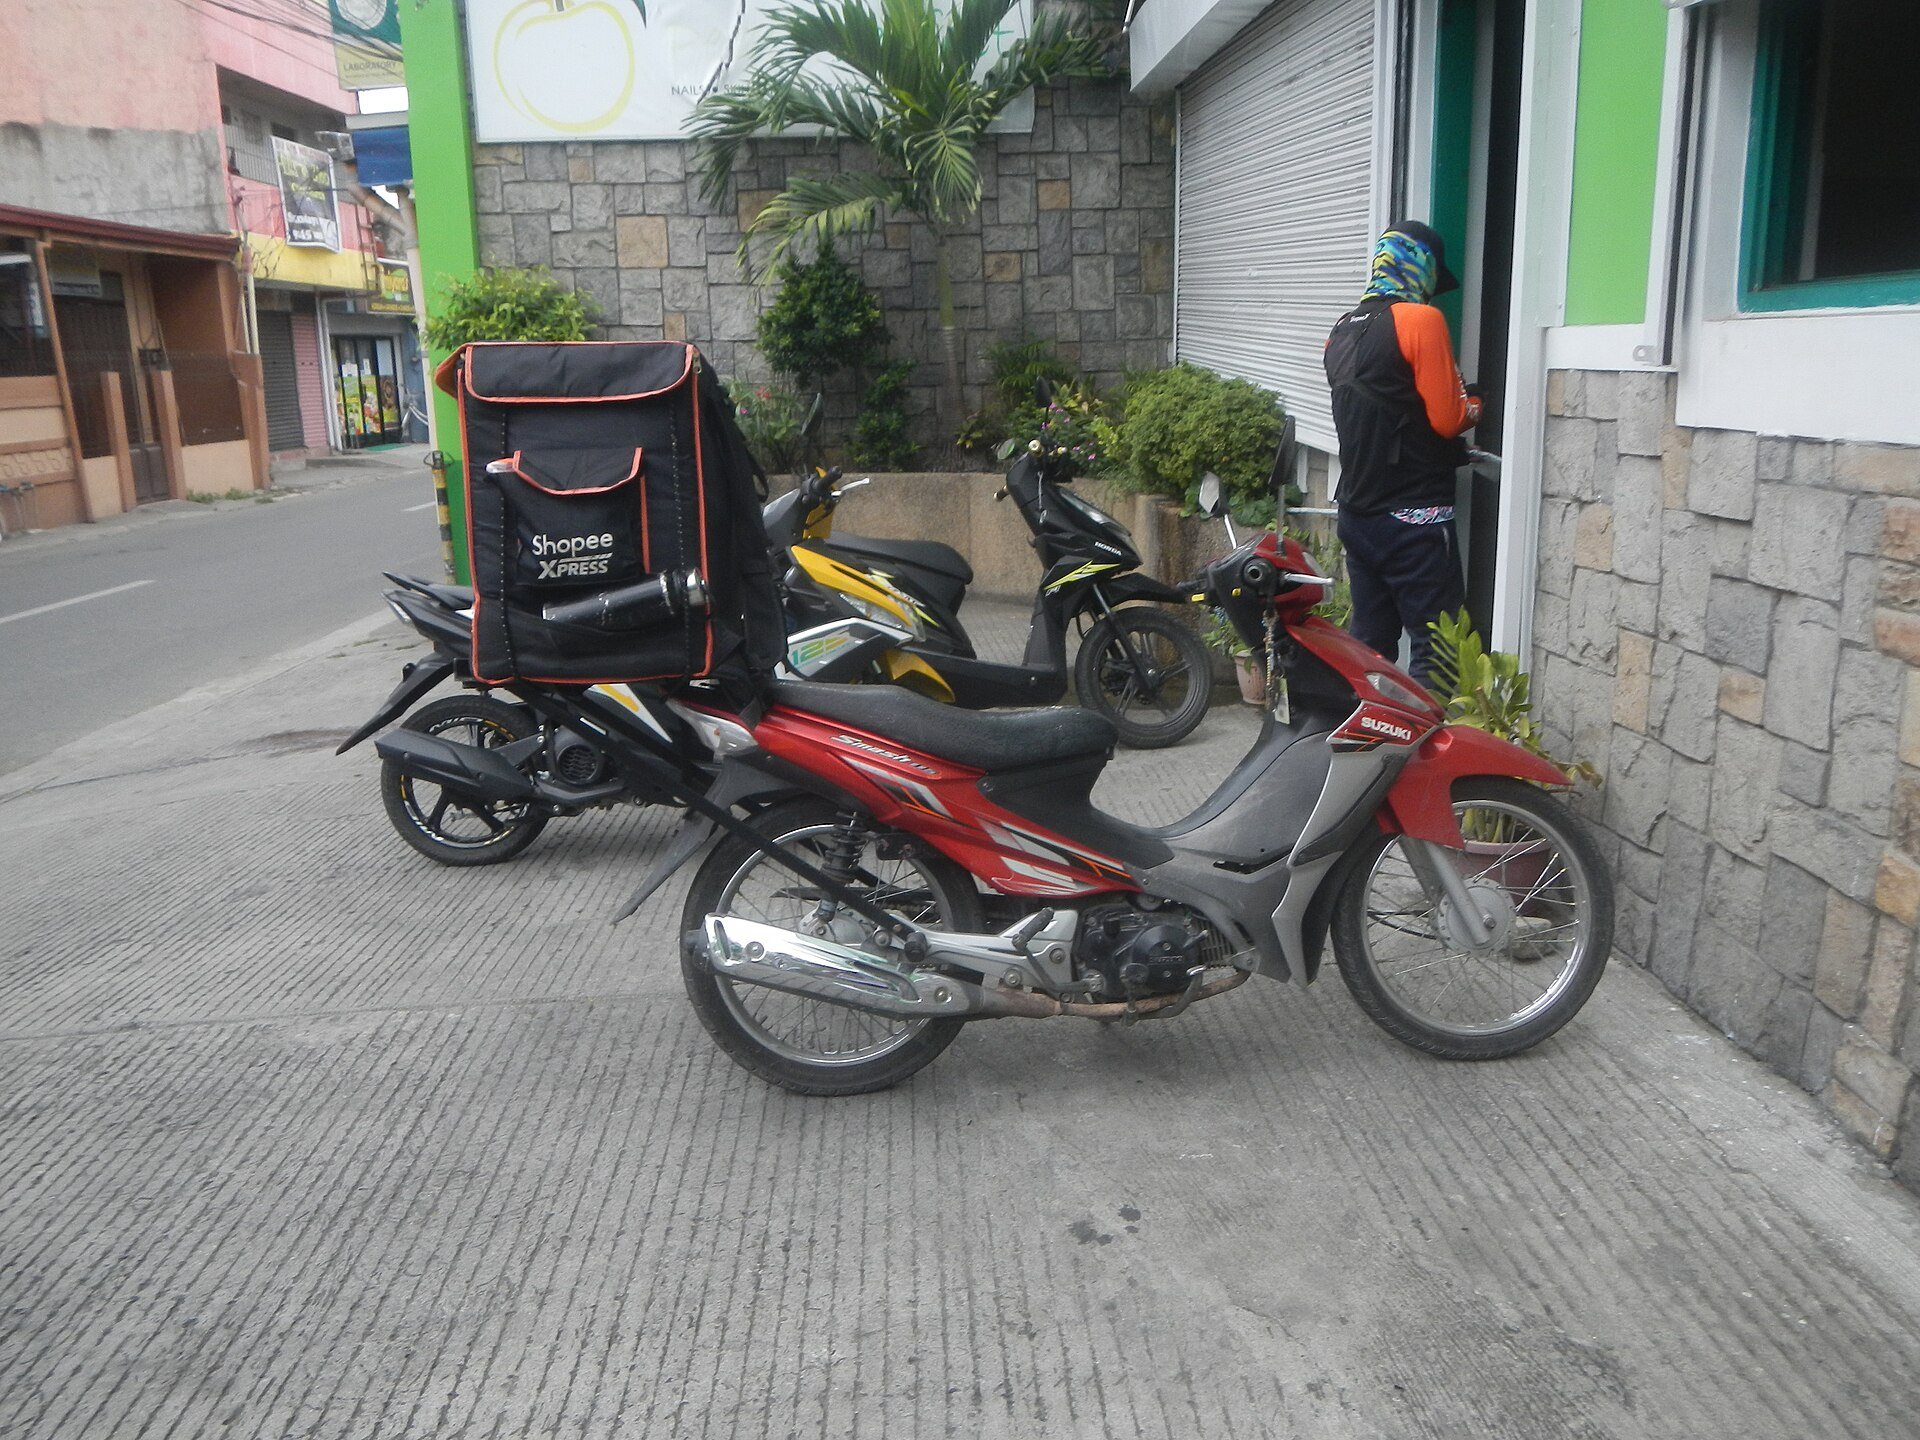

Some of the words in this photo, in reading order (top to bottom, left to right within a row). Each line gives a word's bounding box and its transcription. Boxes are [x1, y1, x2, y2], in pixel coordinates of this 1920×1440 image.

[532, 533, 614, 557] Shopee
[537, 559, 609, 580] XPRESS
[1361, 716, 1412, 741] SUZUKI
[829, 734, 911, 763] Smash
